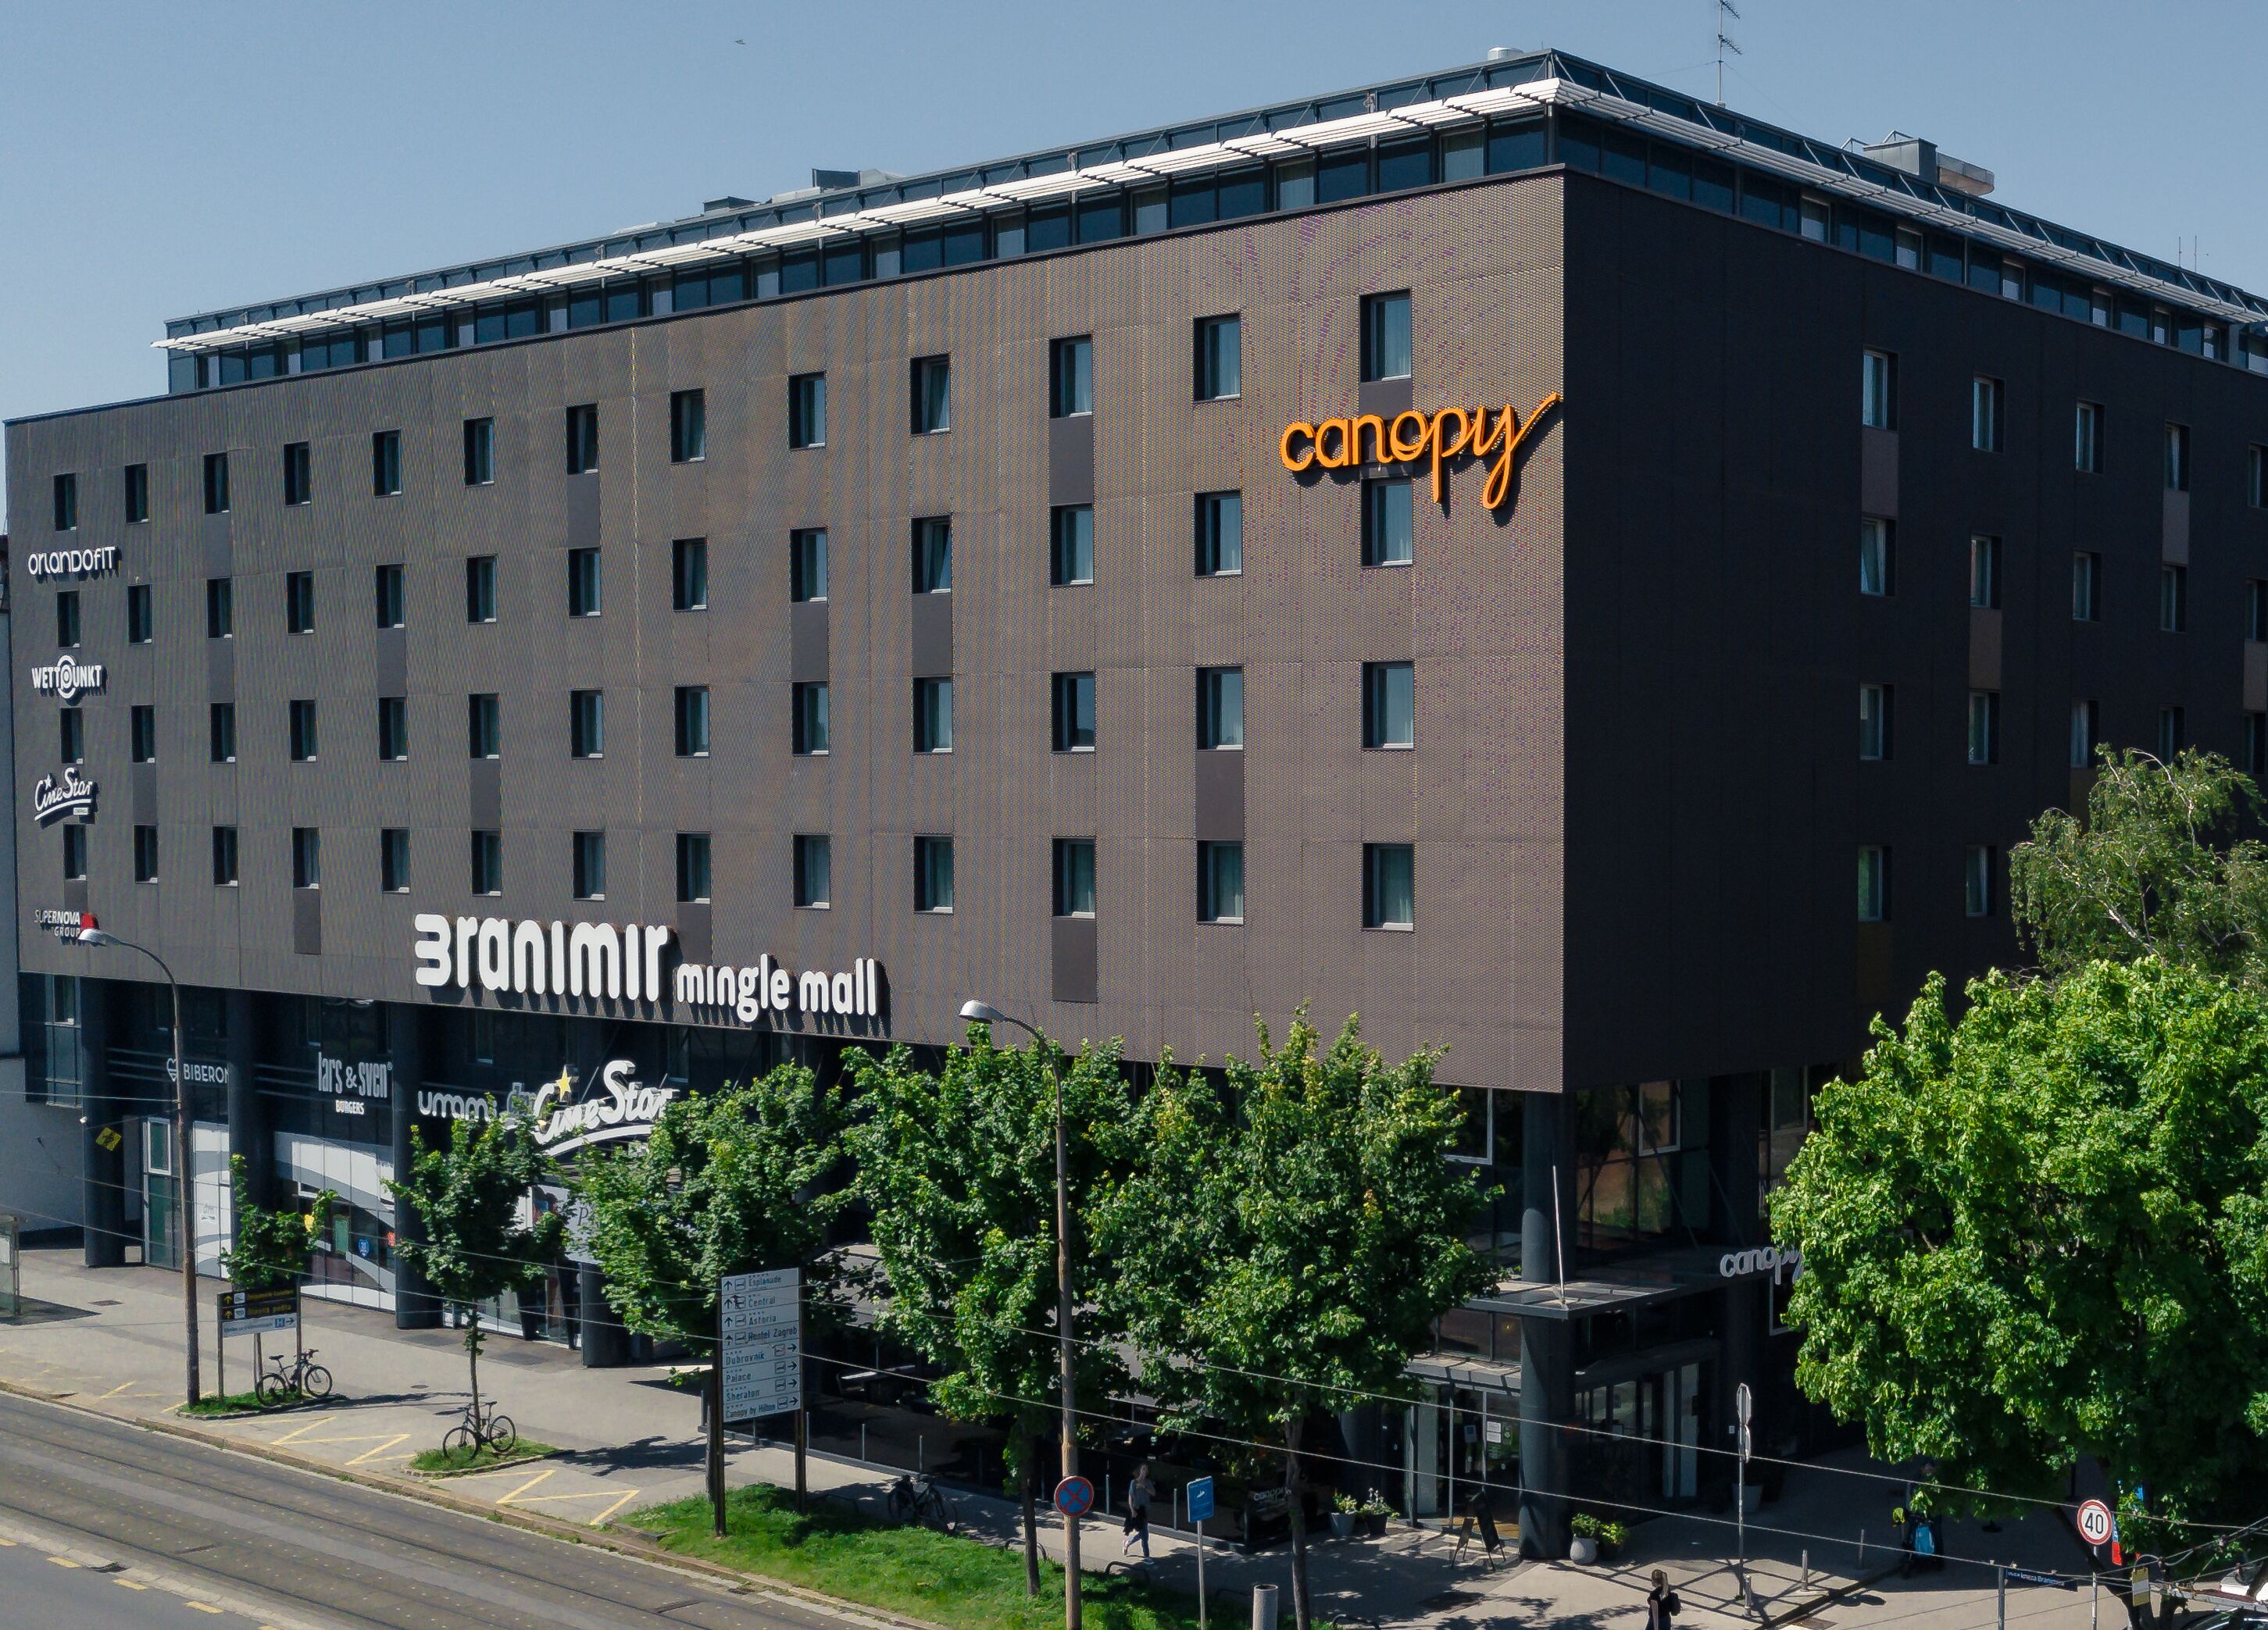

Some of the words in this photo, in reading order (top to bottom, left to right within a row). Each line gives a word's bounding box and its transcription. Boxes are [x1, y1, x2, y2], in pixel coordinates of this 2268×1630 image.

[1280, 392, 1560, 510] canopy
[31, 662, 102, 692] WETTPUNKT
[34, 767, 93, 811] CineStar
[34, 909, 80, 926] SUPERNOVA
[54, 926, 80, 937] GROUP
[677, 953, 790, 1022] mingle
[800, 958, 877, 1015] mall
[346, 1066, 357, 1088] &
[335, 1100, 364, 1115] BURGERS
[748, 1275, 781, 1287] Esplanade
[748, 1297, 776, 1307] Central
[749, 1315, 776, 1325] Astoria
[773, 1326, 798, 1338] Zagreb
[726, 1351, 765, 1365] Dubrovnik
[726, 1373, 751, 1384] Palace
[726, 1389, 760, 1402] Sheraton
[2085, 1512, 2104, 1534] 40
